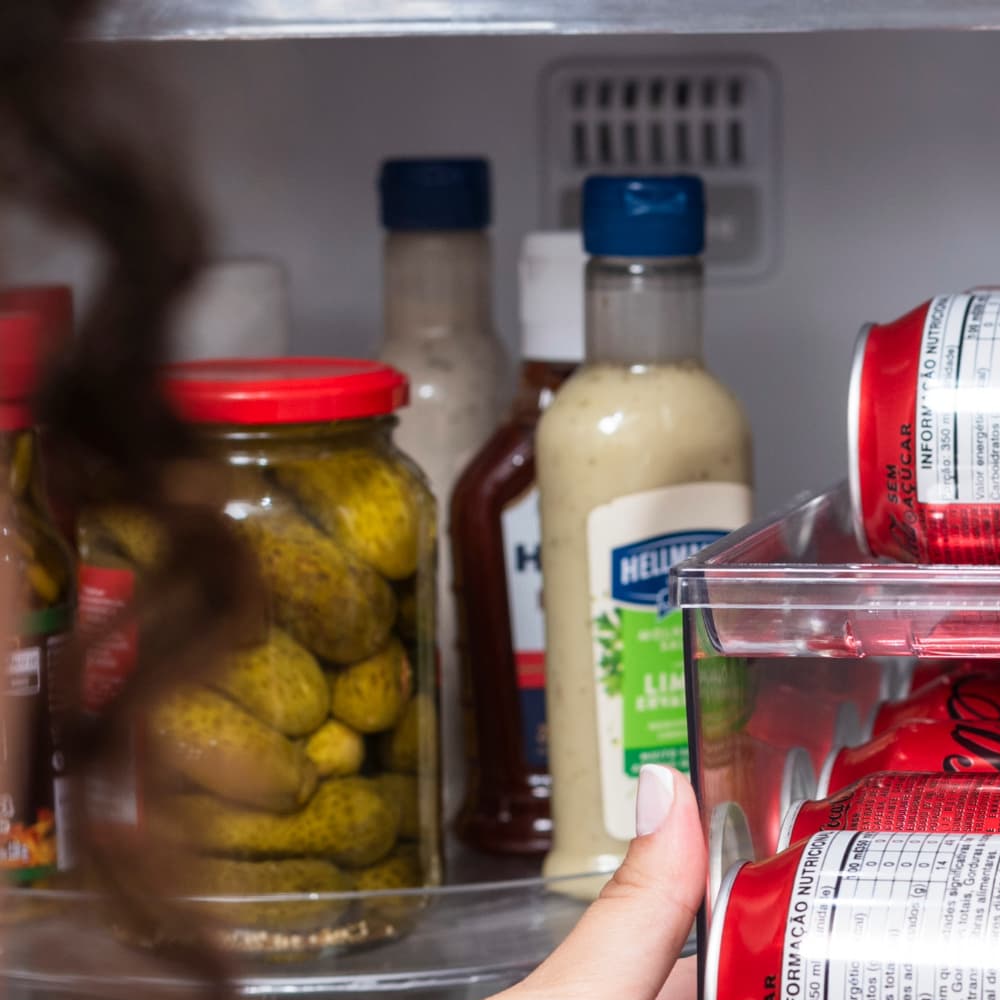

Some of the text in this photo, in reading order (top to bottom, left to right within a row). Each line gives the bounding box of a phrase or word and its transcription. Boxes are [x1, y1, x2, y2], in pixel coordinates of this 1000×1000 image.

[941, 428, 951, 450] 350
[899, 423, 917, 509] AÇÚCAR
[886, 463, 899, 505] SEM
[935, 860, 948, 872] 14
[959, 889, 974, 926] totais,
[809, 961, 821, 977] ml
